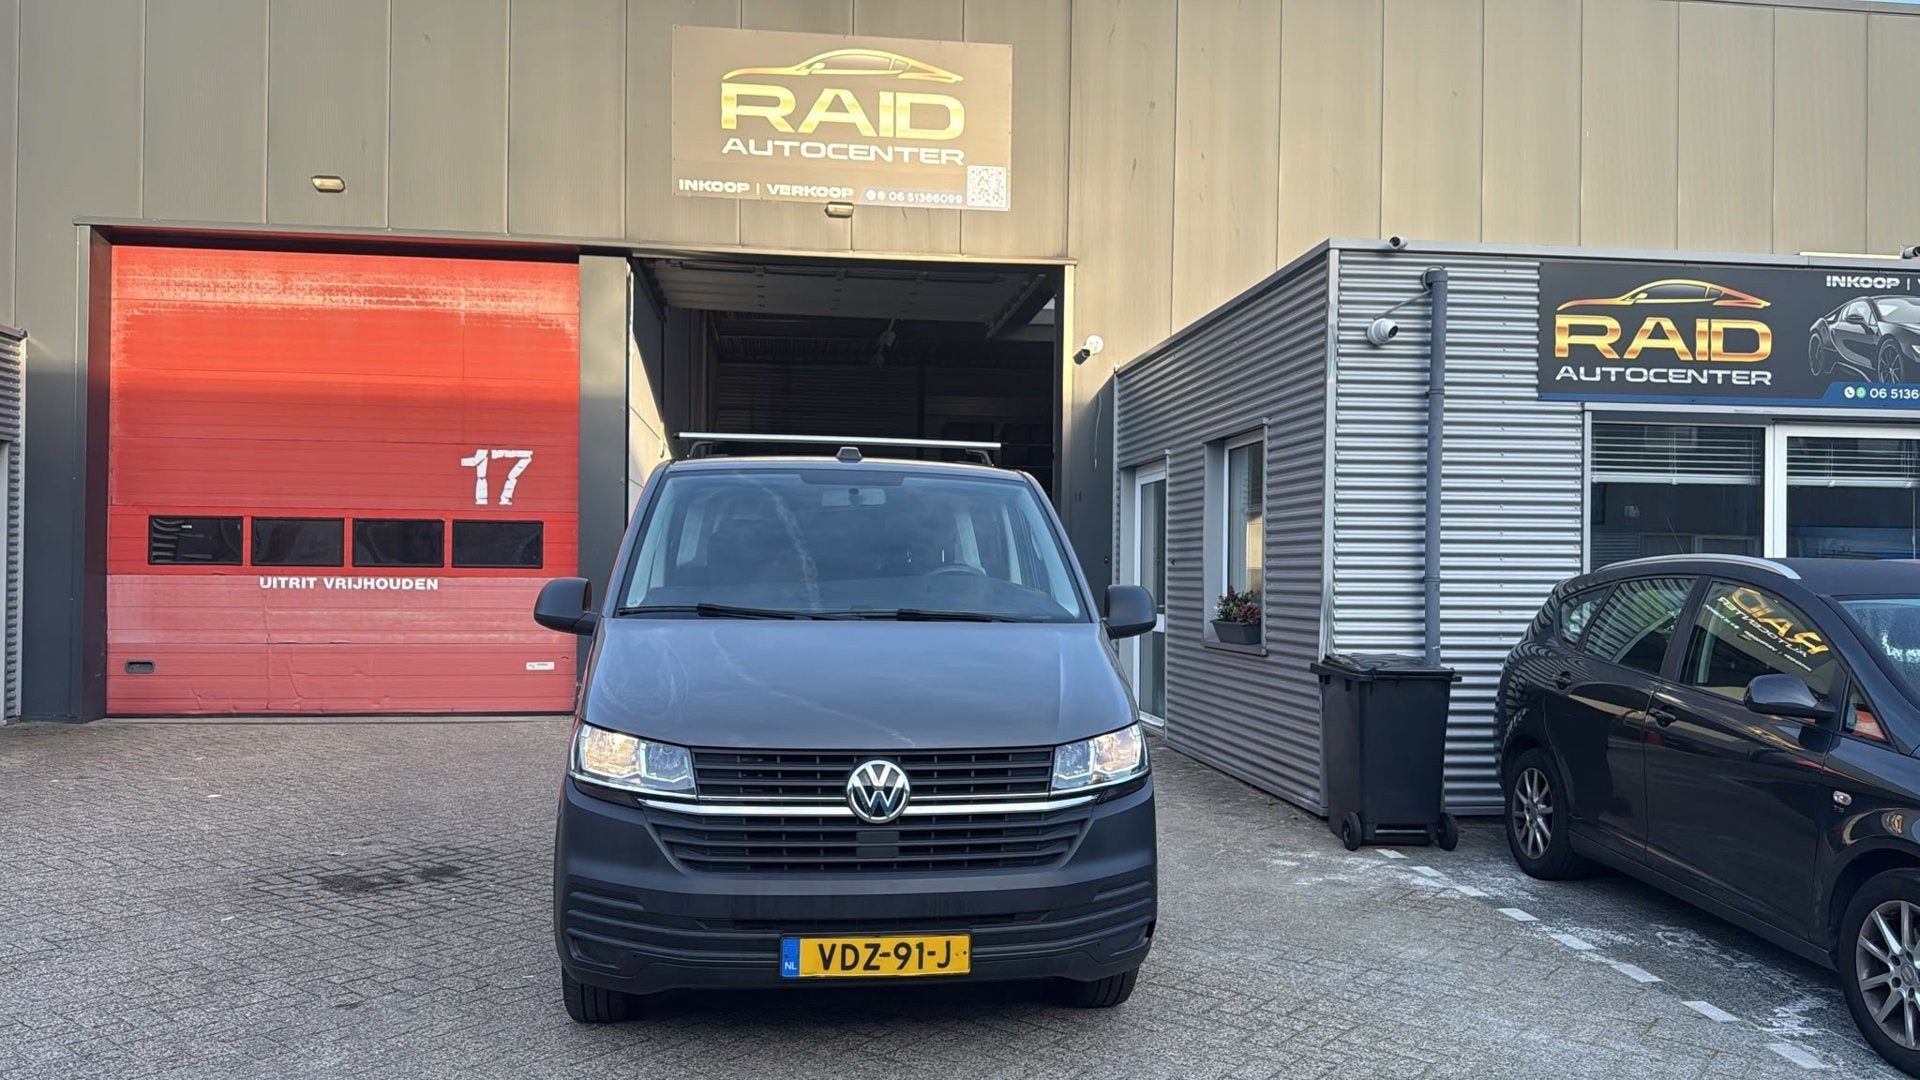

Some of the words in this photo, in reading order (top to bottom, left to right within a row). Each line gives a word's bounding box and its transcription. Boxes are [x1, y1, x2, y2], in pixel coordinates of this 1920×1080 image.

[721, 82, 966, 140] RAID
[721, 137, 965, 166] AUTOCENTER
[678, 179, 750, 194] INKOOP
[766, 183, 854, 198] VERKOOP
[888, 191, 905, 202] 06
[1826, 275, 1901, 289] INKOOP
[1555, 314, 1773, 363] RAID
[1555, 366, 1772, 386] AUTOCENTER
[1869, 387, 1887, 399] 06
[1890, 388, 1920, 400] 5136
[460, 449, 533, 505] 17
[259, 576, 318, 589] UITRIT
[323, 577, 439, 590] VRIJHOUDEN
[818, 940, 951, 971] VDZ-91-J
[784, 960, 797, 971] NL
